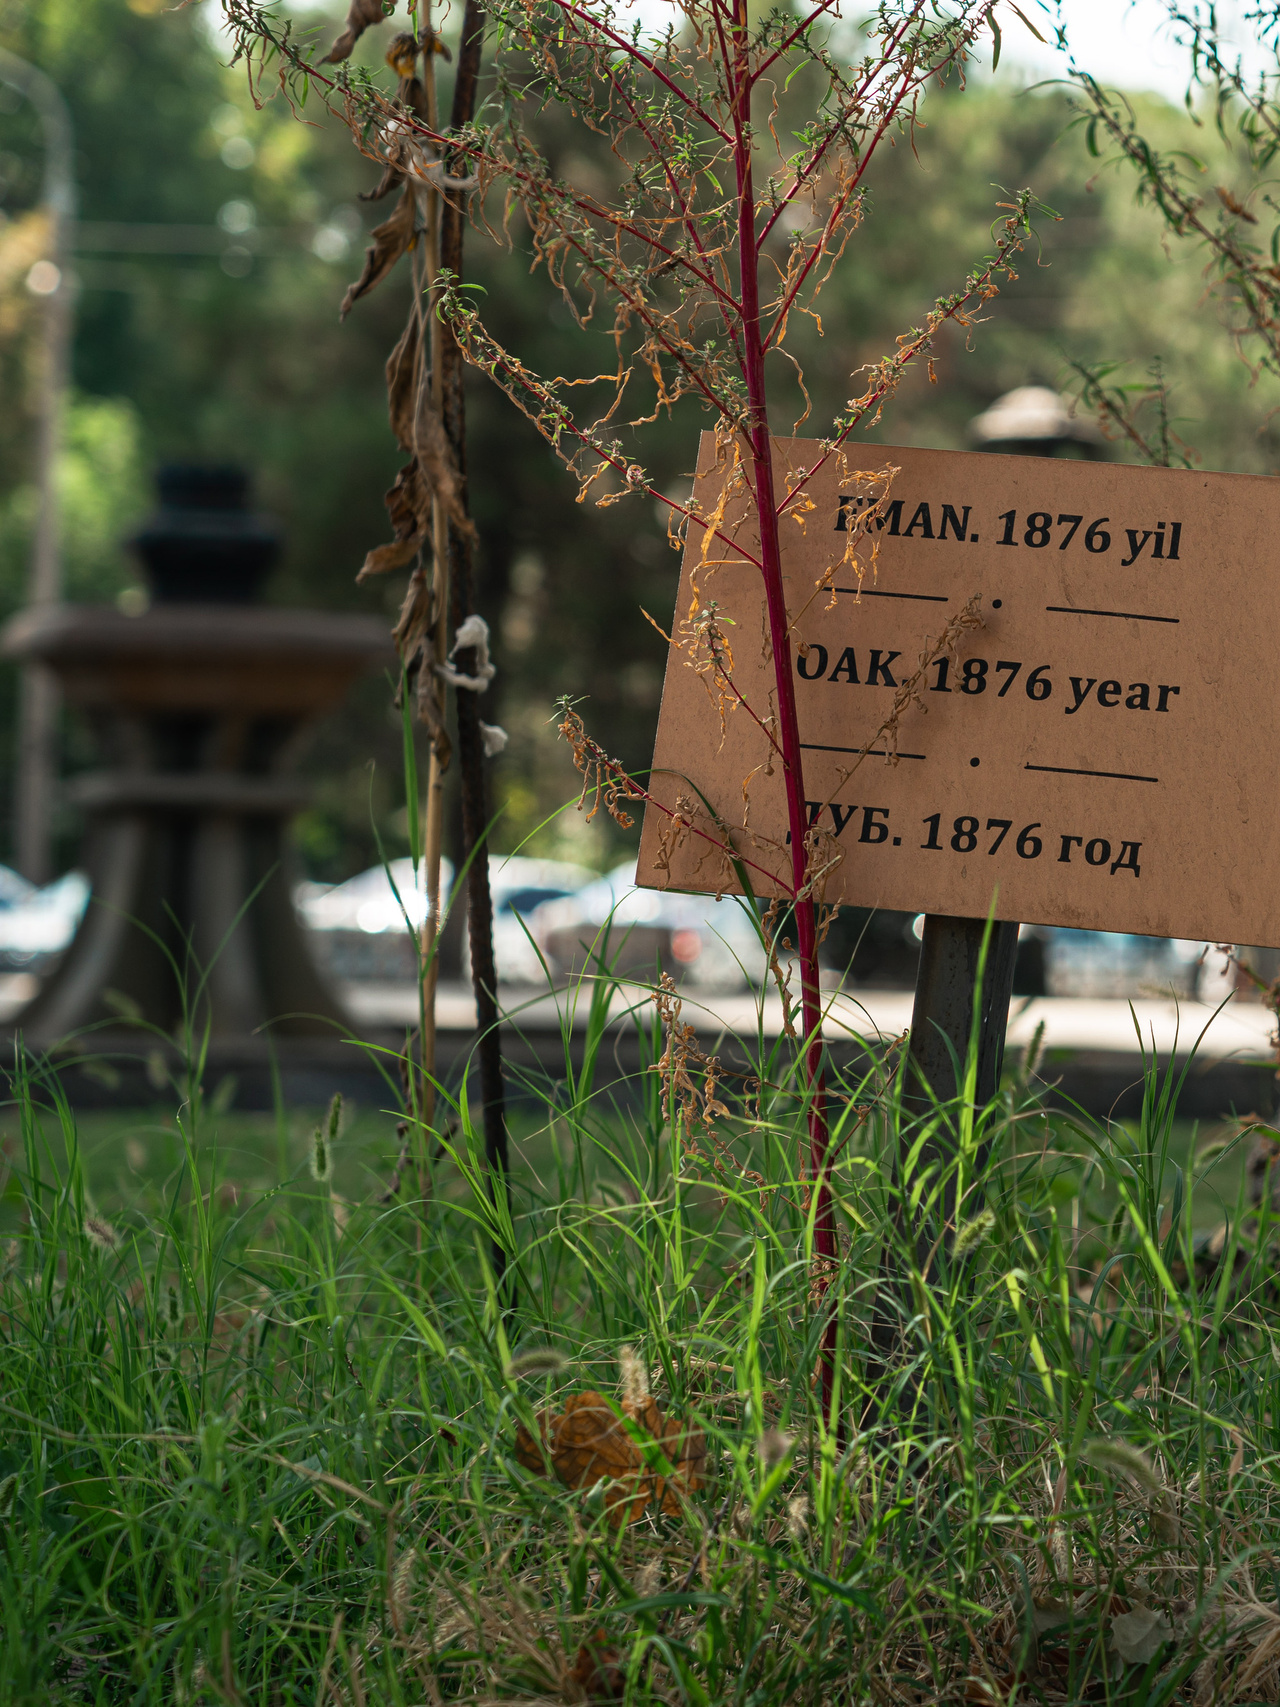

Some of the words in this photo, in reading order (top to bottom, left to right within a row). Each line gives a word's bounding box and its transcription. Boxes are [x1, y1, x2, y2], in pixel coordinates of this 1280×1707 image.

[996, 509, 1112, 554] 1876
[1121, 521, 1182, 566] yil
[929, 656, 1053, 701] 1876
[1064, 674, 1181, 715] year
[920, 813, 1043, 859] 1876
[1057, 834, 1143, 878] год
